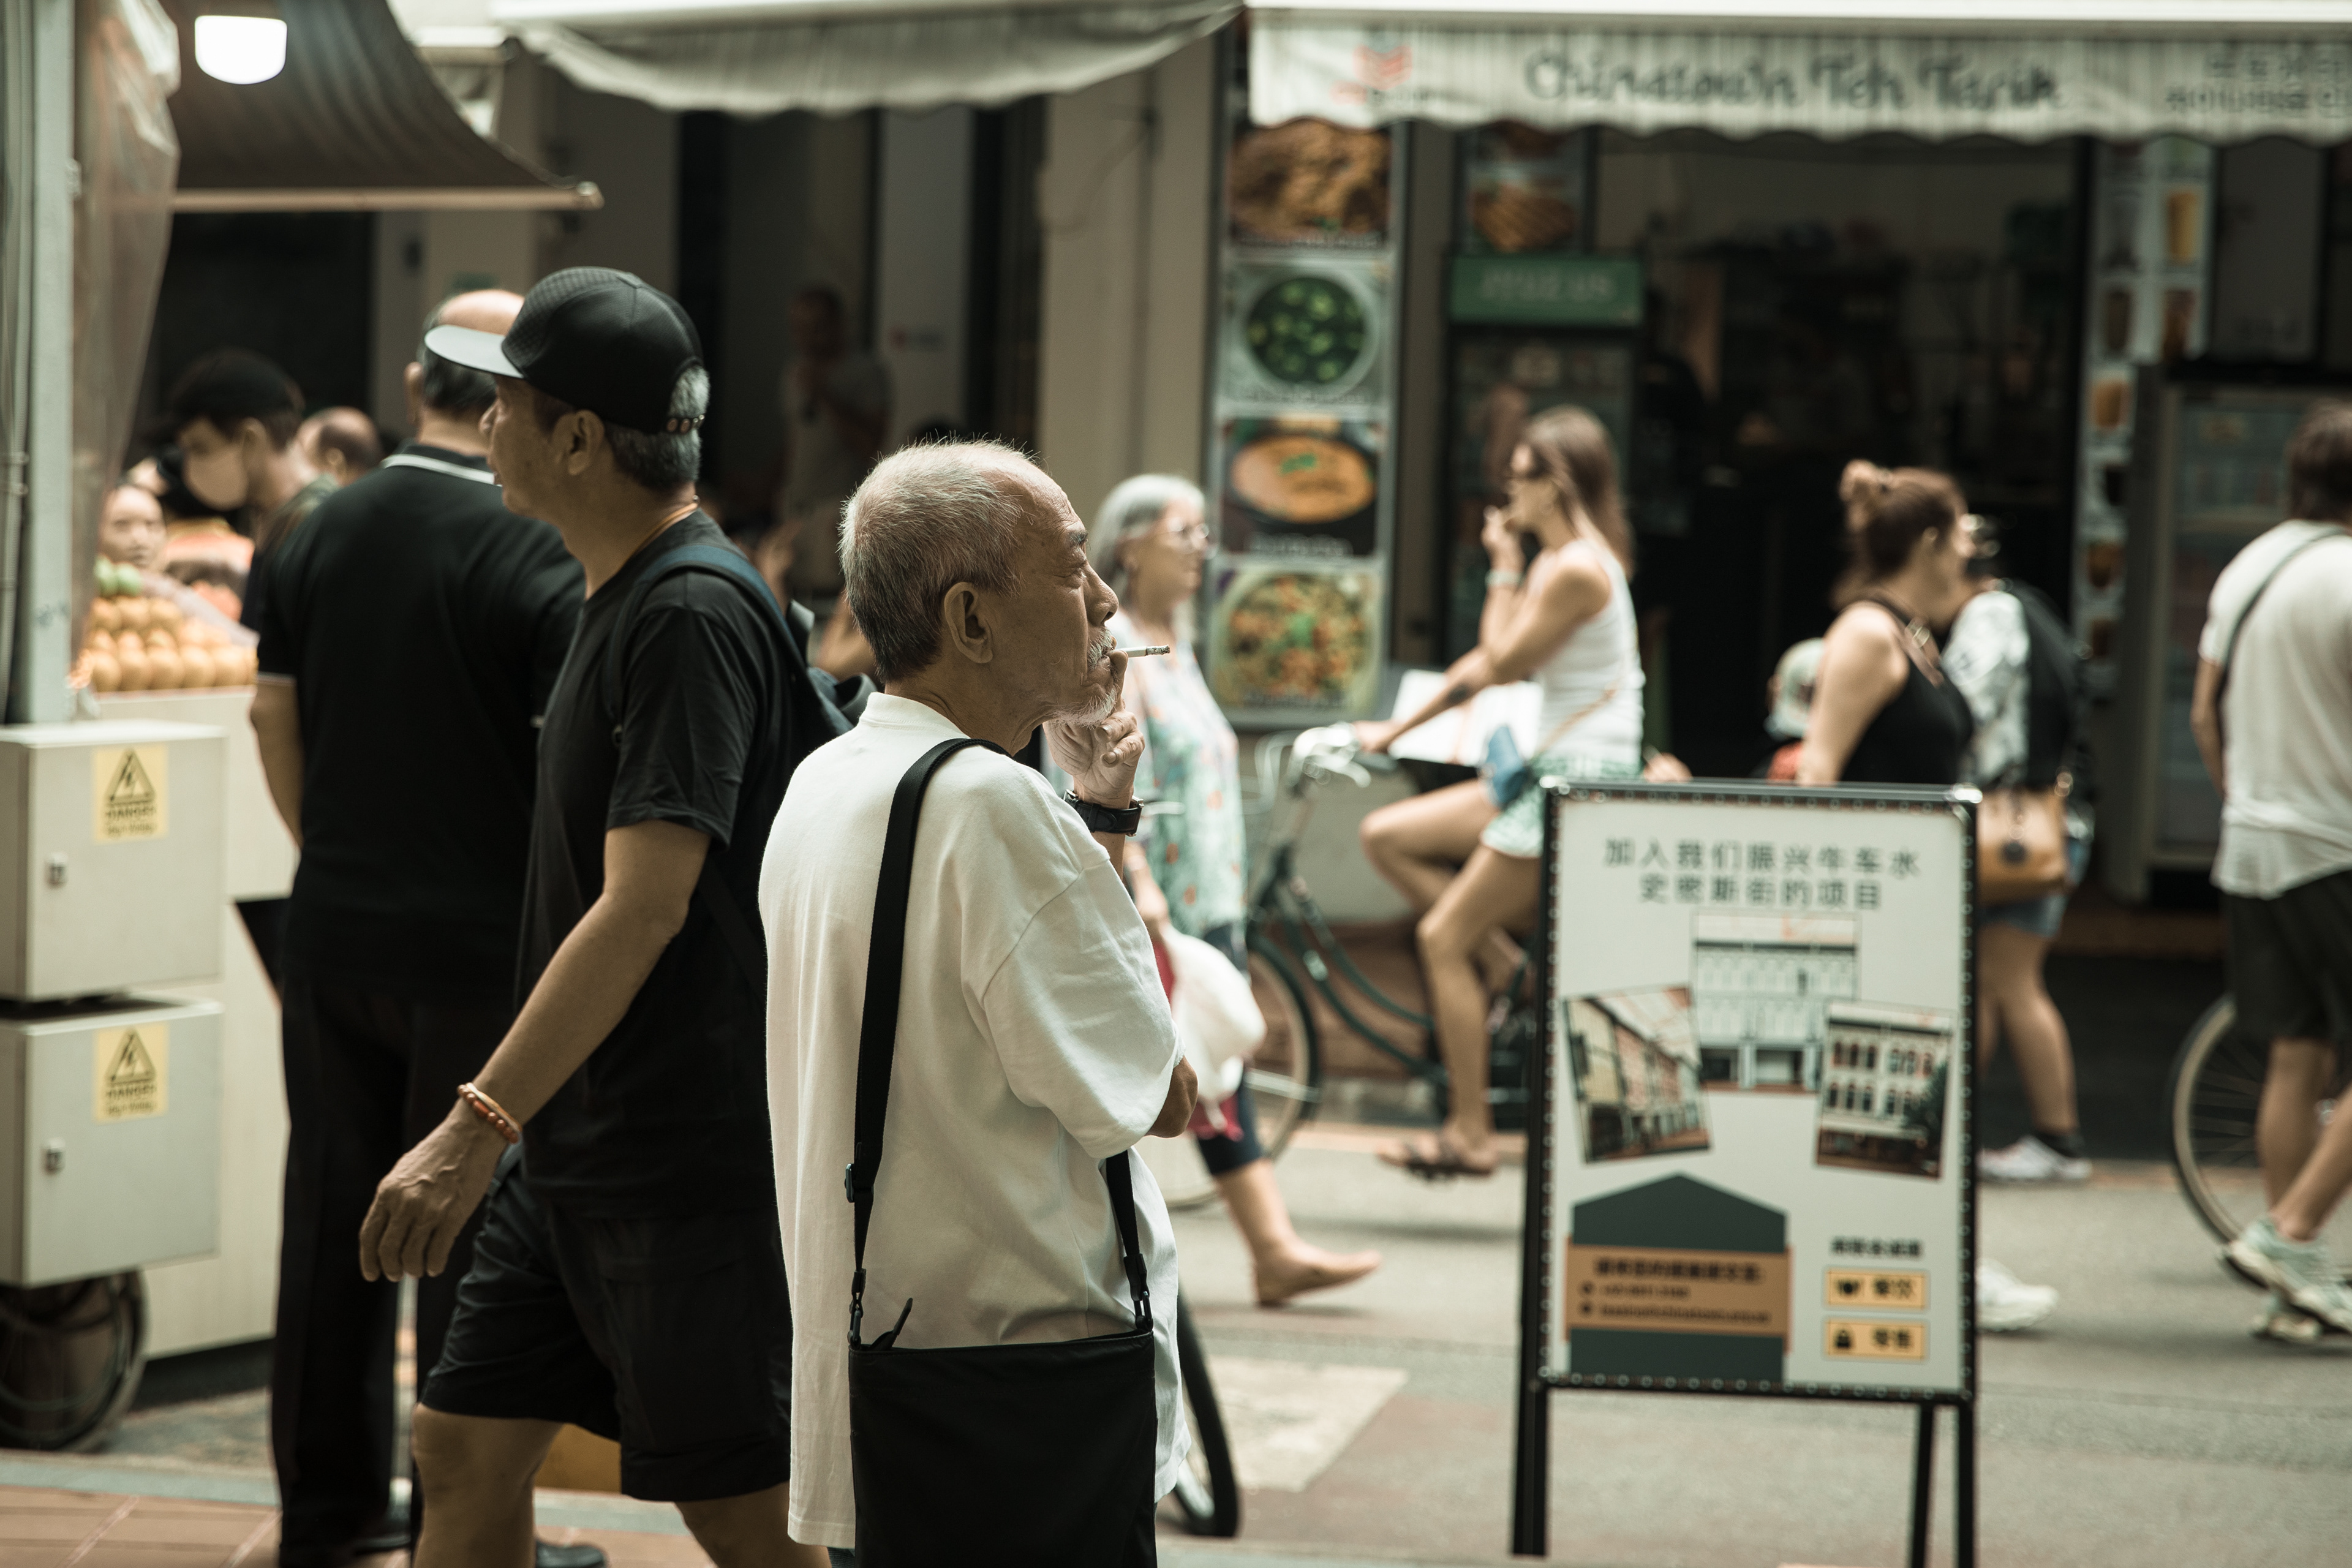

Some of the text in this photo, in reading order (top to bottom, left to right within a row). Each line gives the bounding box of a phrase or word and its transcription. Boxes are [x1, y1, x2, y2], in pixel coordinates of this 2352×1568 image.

[1523, 49, 1800, 110] Chinatown
[1809, 50, 1907, 111] Teh
[1915, 53, 2063, 111] Tarik
[1603, 837, 1921, 879] 加入我们振兴牛车水
